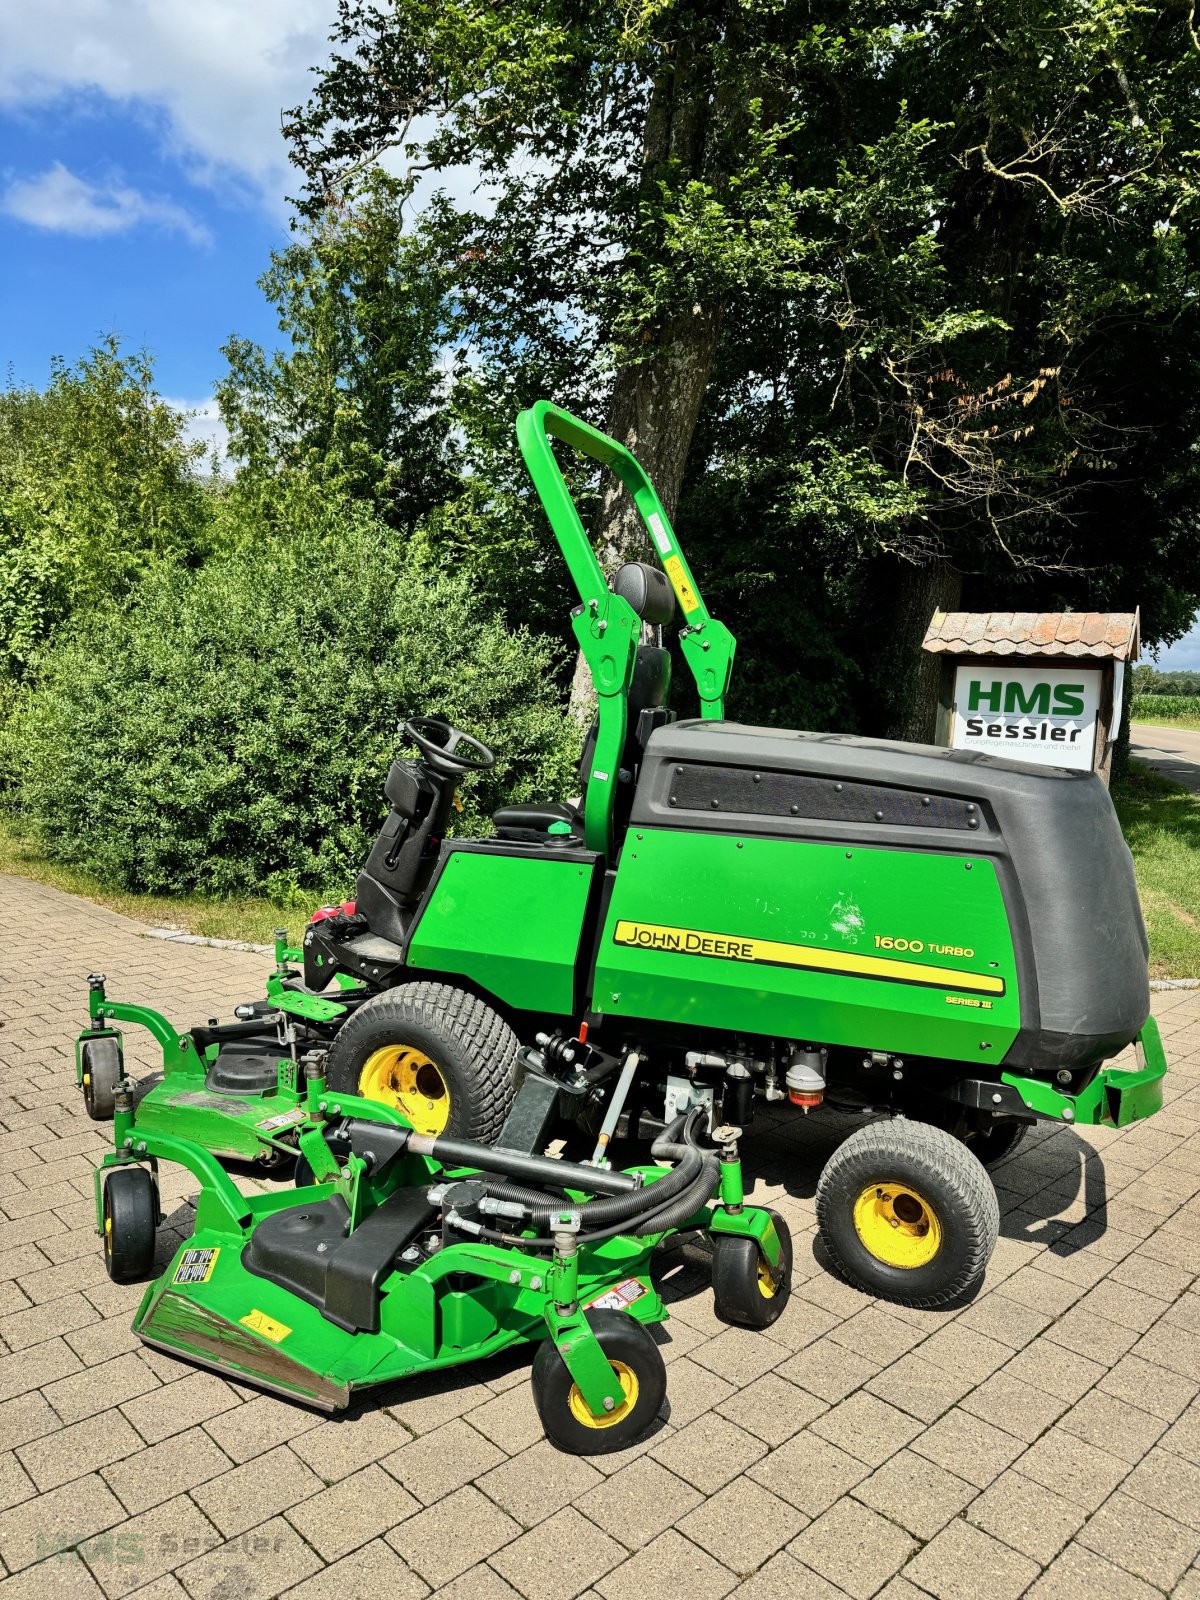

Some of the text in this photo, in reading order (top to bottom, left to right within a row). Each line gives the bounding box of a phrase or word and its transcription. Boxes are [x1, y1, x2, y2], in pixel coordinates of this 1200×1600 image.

[968, 681, 1085, 716] HMS
[966, 719, 1082, 742] Sessler
[627, 927, 754, 958] JOHN DEERE
[874, 935, 975, 958] 1600 TURBO
[945, 996, 993, 1010] SERIES III
